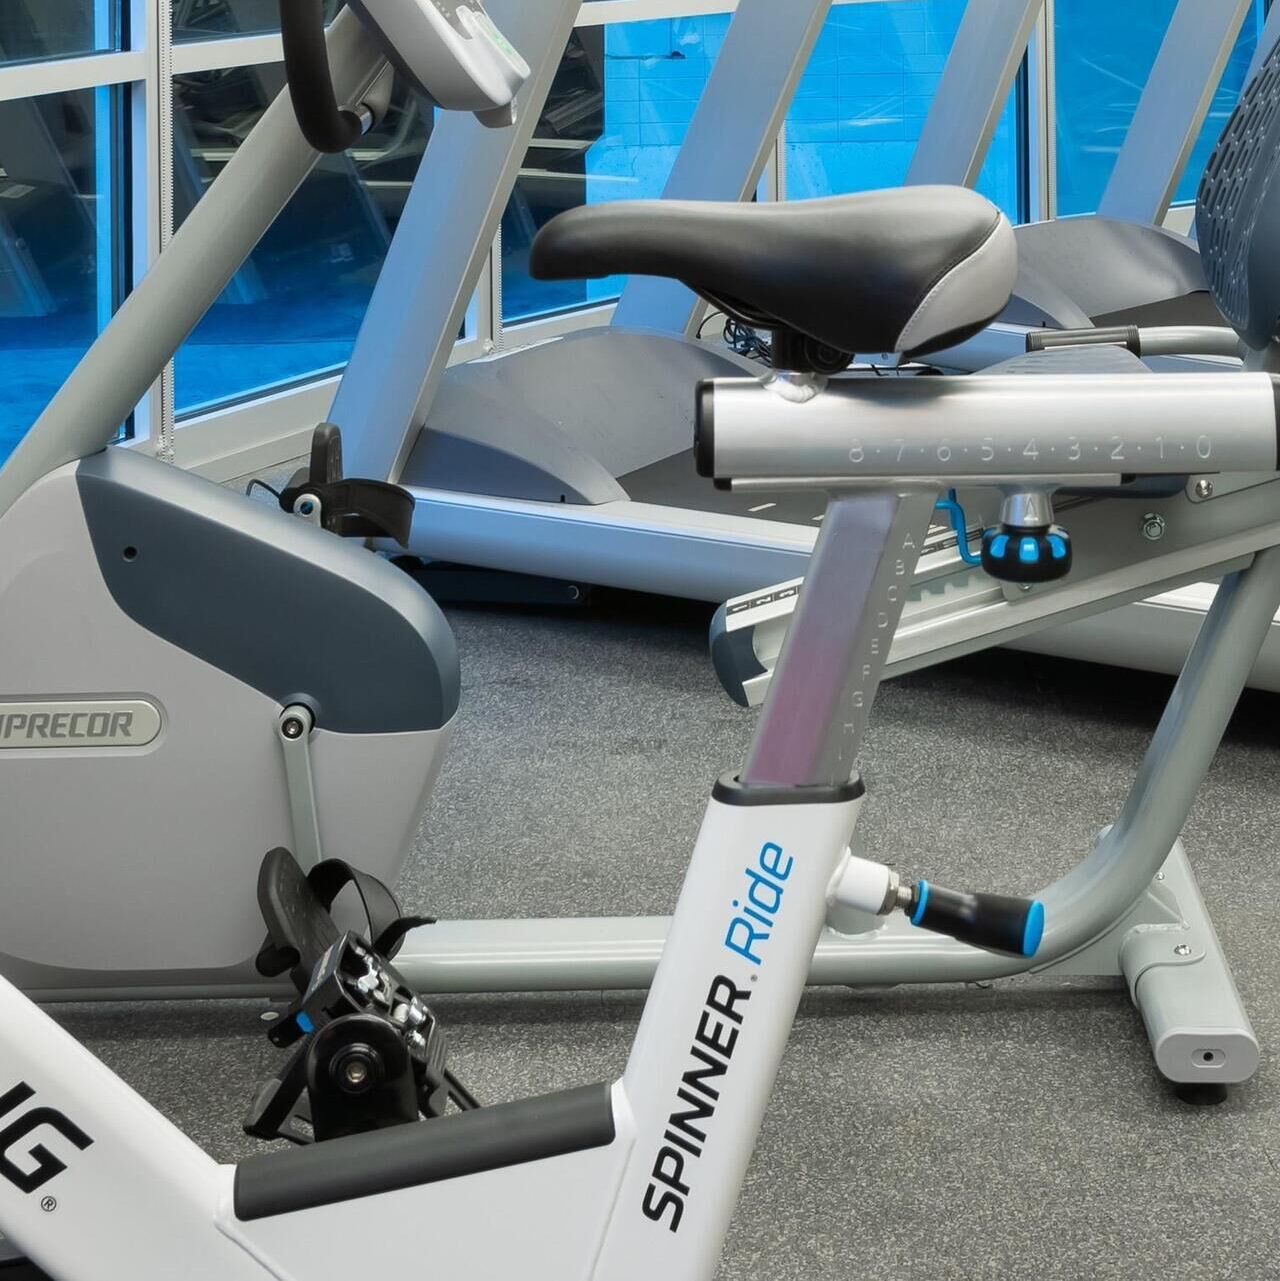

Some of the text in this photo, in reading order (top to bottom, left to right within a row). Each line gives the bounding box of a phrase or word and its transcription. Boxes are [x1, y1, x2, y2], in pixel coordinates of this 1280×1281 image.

[848, 435, 1212, 463] 8 7 6 5 4 3 2 1 0
[2, 710, 133, 739] PRECOR
[642, 841, 794, 1233] SPINNER Ride
